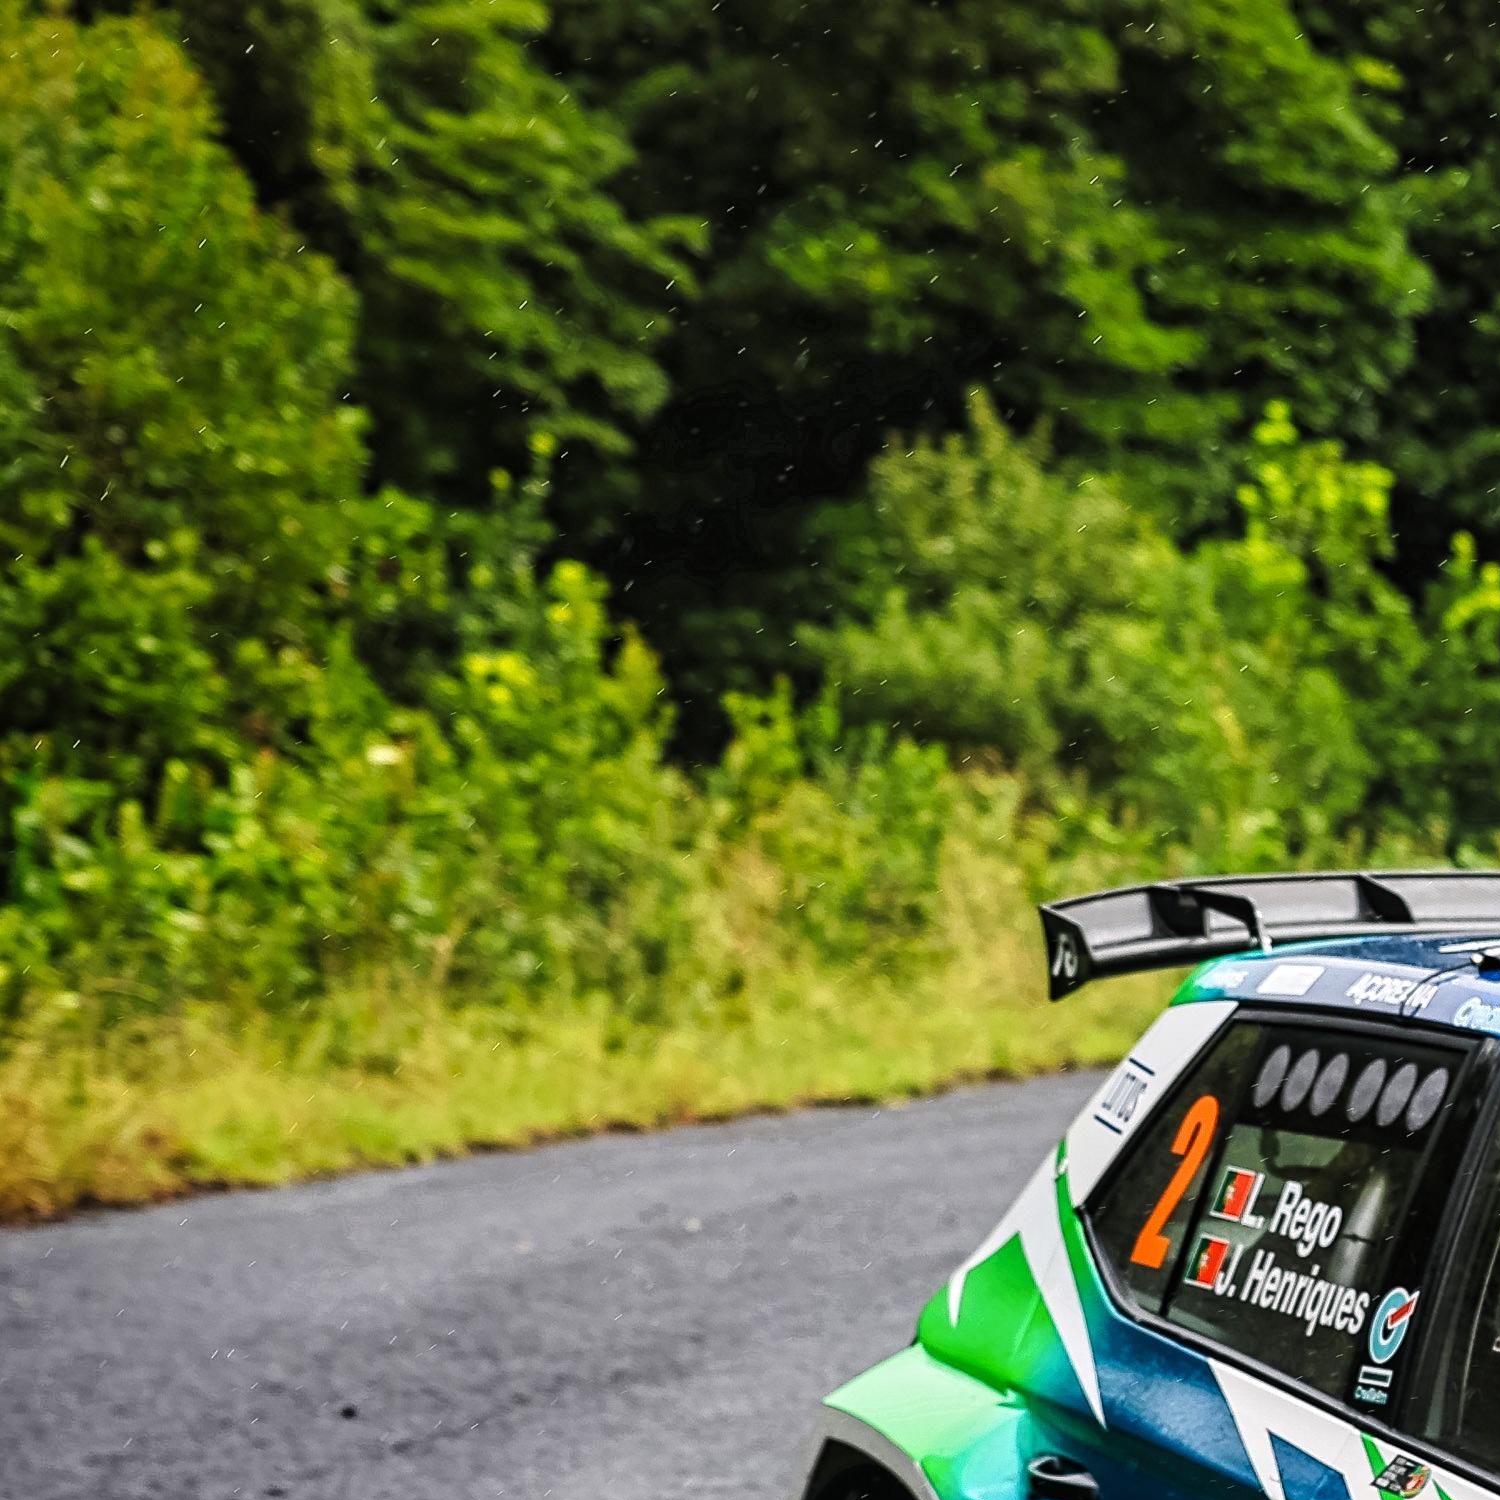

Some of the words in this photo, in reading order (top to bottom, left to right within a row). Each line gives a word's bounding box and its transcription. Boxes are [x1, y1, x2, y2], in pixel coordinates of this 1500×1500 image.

[1130, 1095, 1220, 1269] 2
[1269, 1180, 1344, 1258] Rego
[1240, 1248, 1371, 1338] Henriques
